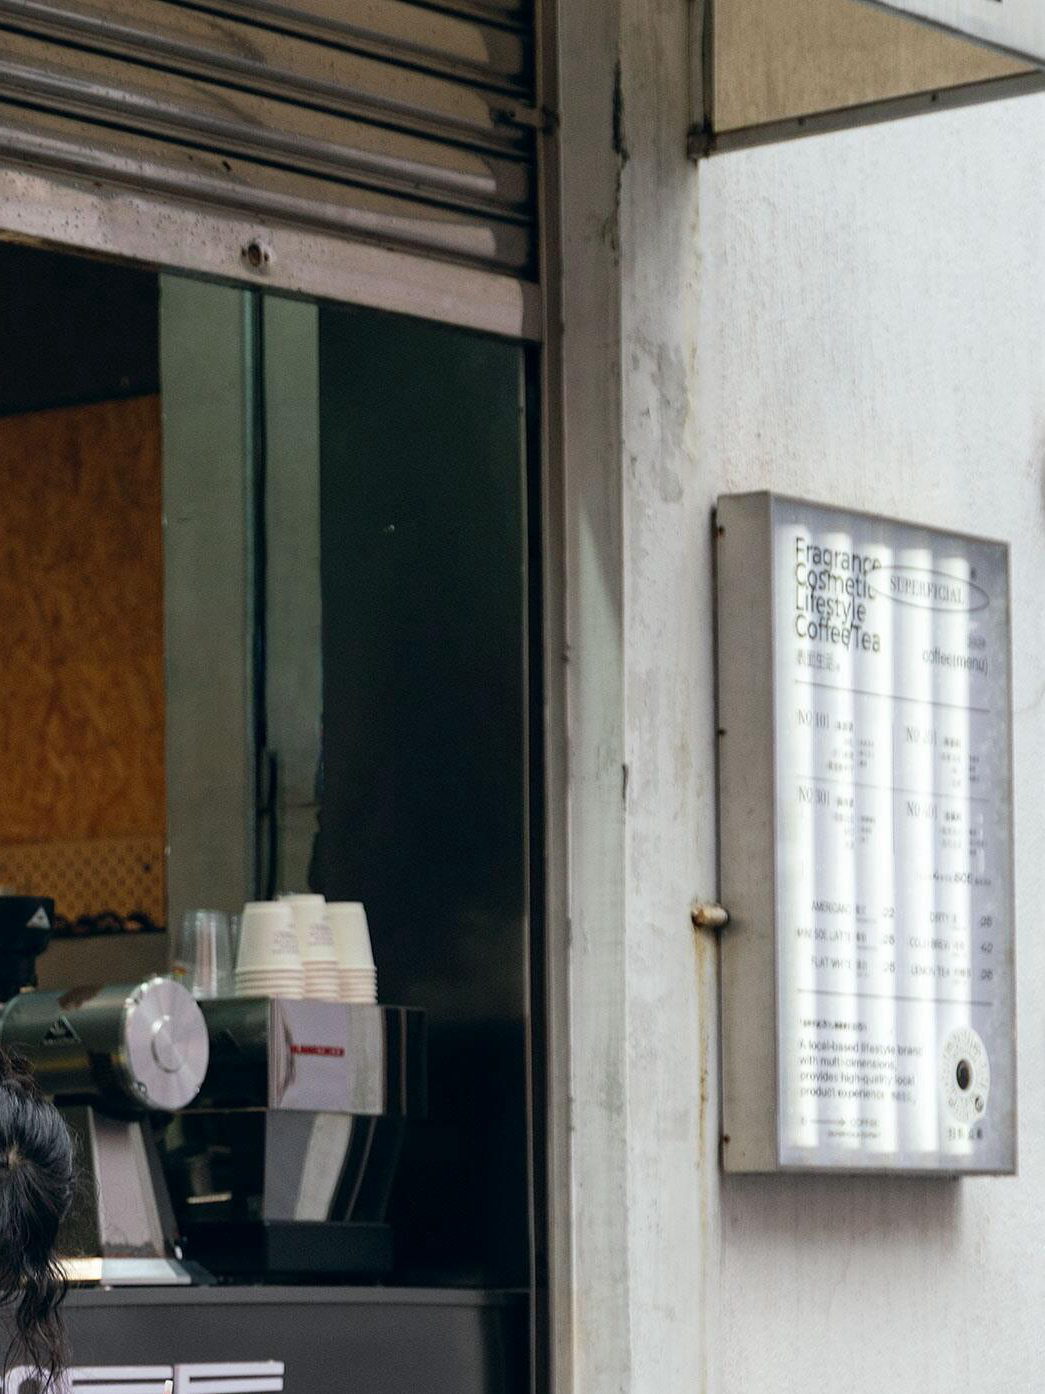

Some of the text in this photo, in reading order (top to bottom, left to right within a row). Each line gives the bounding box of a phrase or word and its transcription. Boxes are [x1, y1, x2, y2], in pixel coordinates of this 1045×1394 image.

[795, 537, 883, 575] Fragrance
[794, 563, 877, 600] Cosmetic
[890, 576, 965, 604] SUPERFICIAL
[795, 584, 867, 625] Lifestyle
[808, 1041, 859, 1053] local-based
